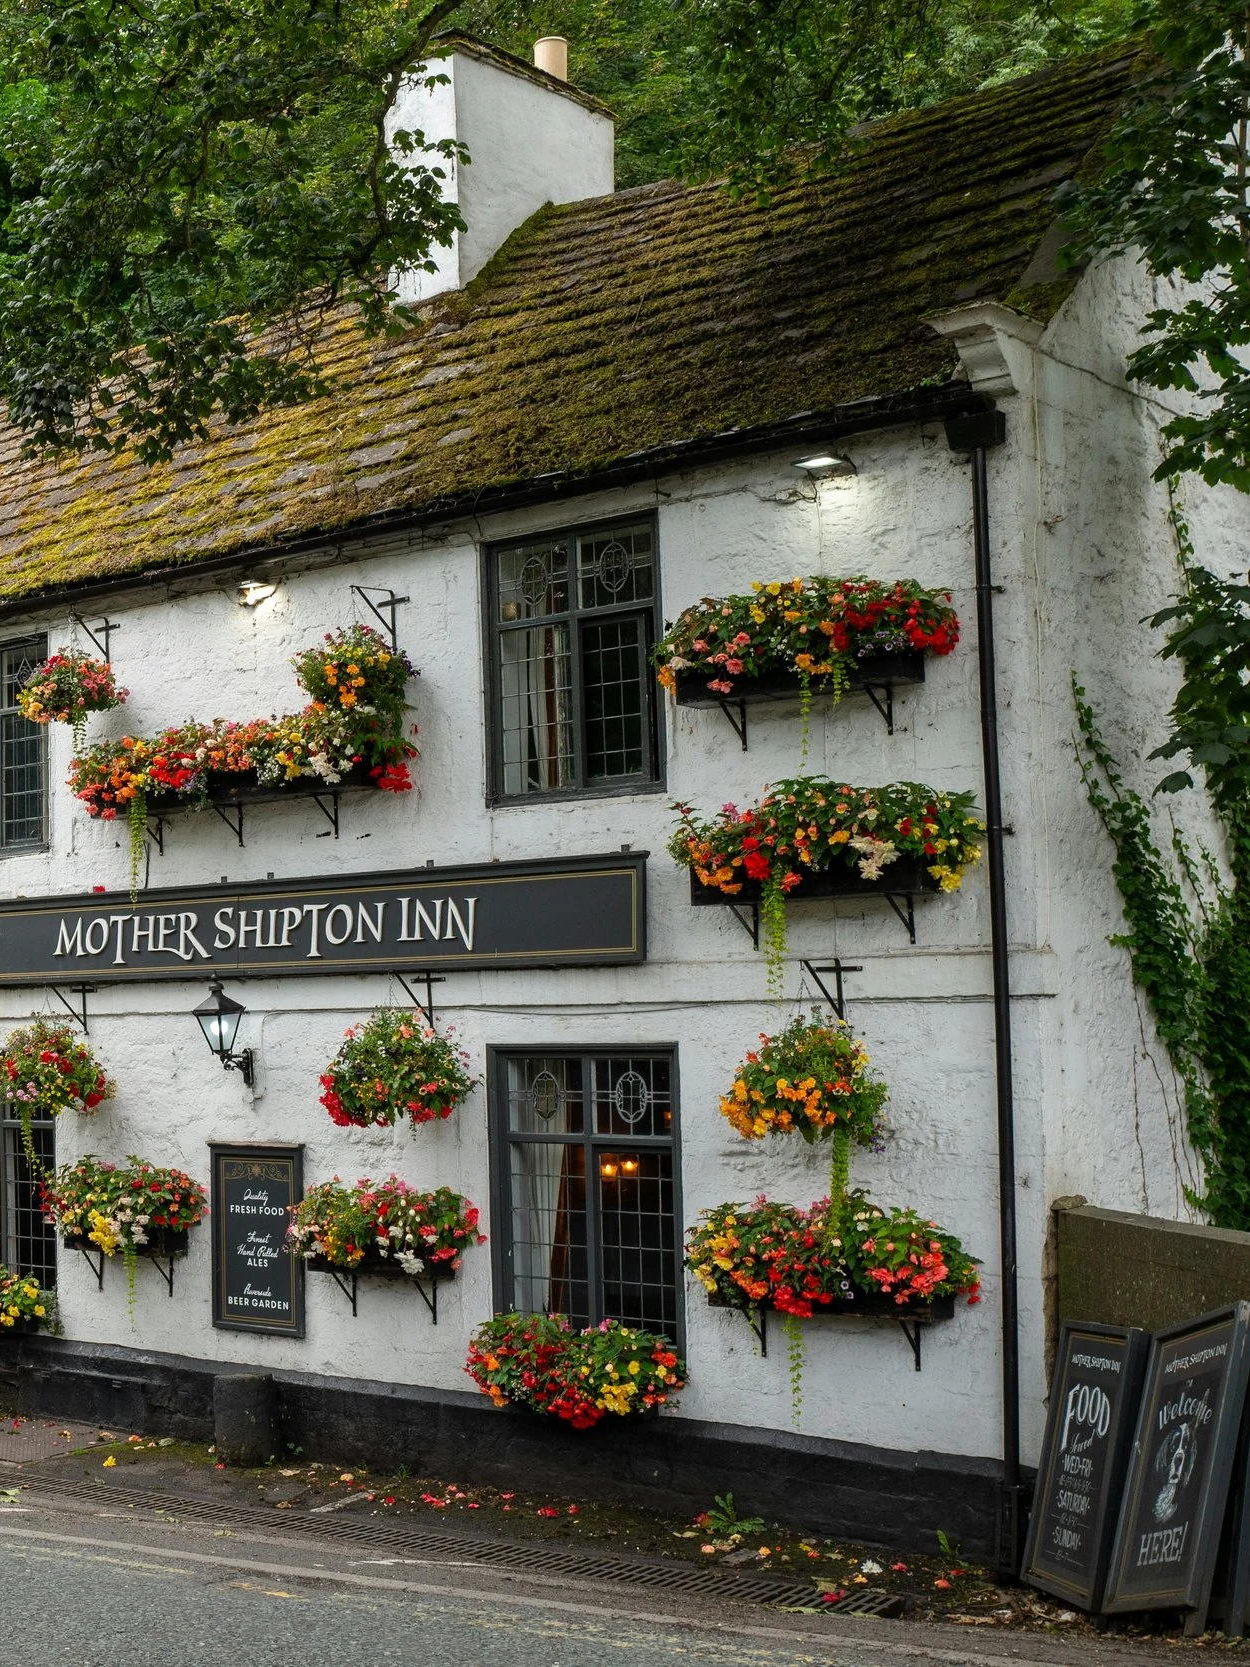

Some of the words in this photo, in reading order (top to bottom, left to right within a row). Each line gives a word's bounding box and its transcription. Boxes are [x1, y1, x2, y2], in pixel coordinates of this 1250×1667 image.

[53, 912, 212, 964] MOTHER
[214, 902, 387, 958] SHIPTON
[396, 897, 478, 951] INN
[244, 1189, 269, 1206] Quality
[230, 1204, 257, 1215] FRESH
[259, 1206, 285, 1216] FOOD
[247, 1231, 271, 1244] Finest
[237, 1244, 256, 1257] Hand
[256, 1245, 279, 1258] Pulled
[247, 1258, 268, 1268] ALES
[244, 1283, 272, 1297] Riverside
[228, 1296, 250, 1306] BEER
[251, 1298, 289, 1310] GARDEN
[1072, 1353, 1091, 1368] MOTHER
[1091, 1356, 1111, 1371] SHIPTON
[1165, 1357, 1189, 1374] MOTHER
[1190, 1347, 1216, 1366] SHIPTON
[1215, 1343, 1228, 1356] INN
[1060, 1383, 1110, 1452] FOOD
[1058, 1489, 1090, 1516] SATURDAY
[1053, 1526, 1081, 1551] SUNDAY
[1137, 1521, 1189, 1566] HERE!
